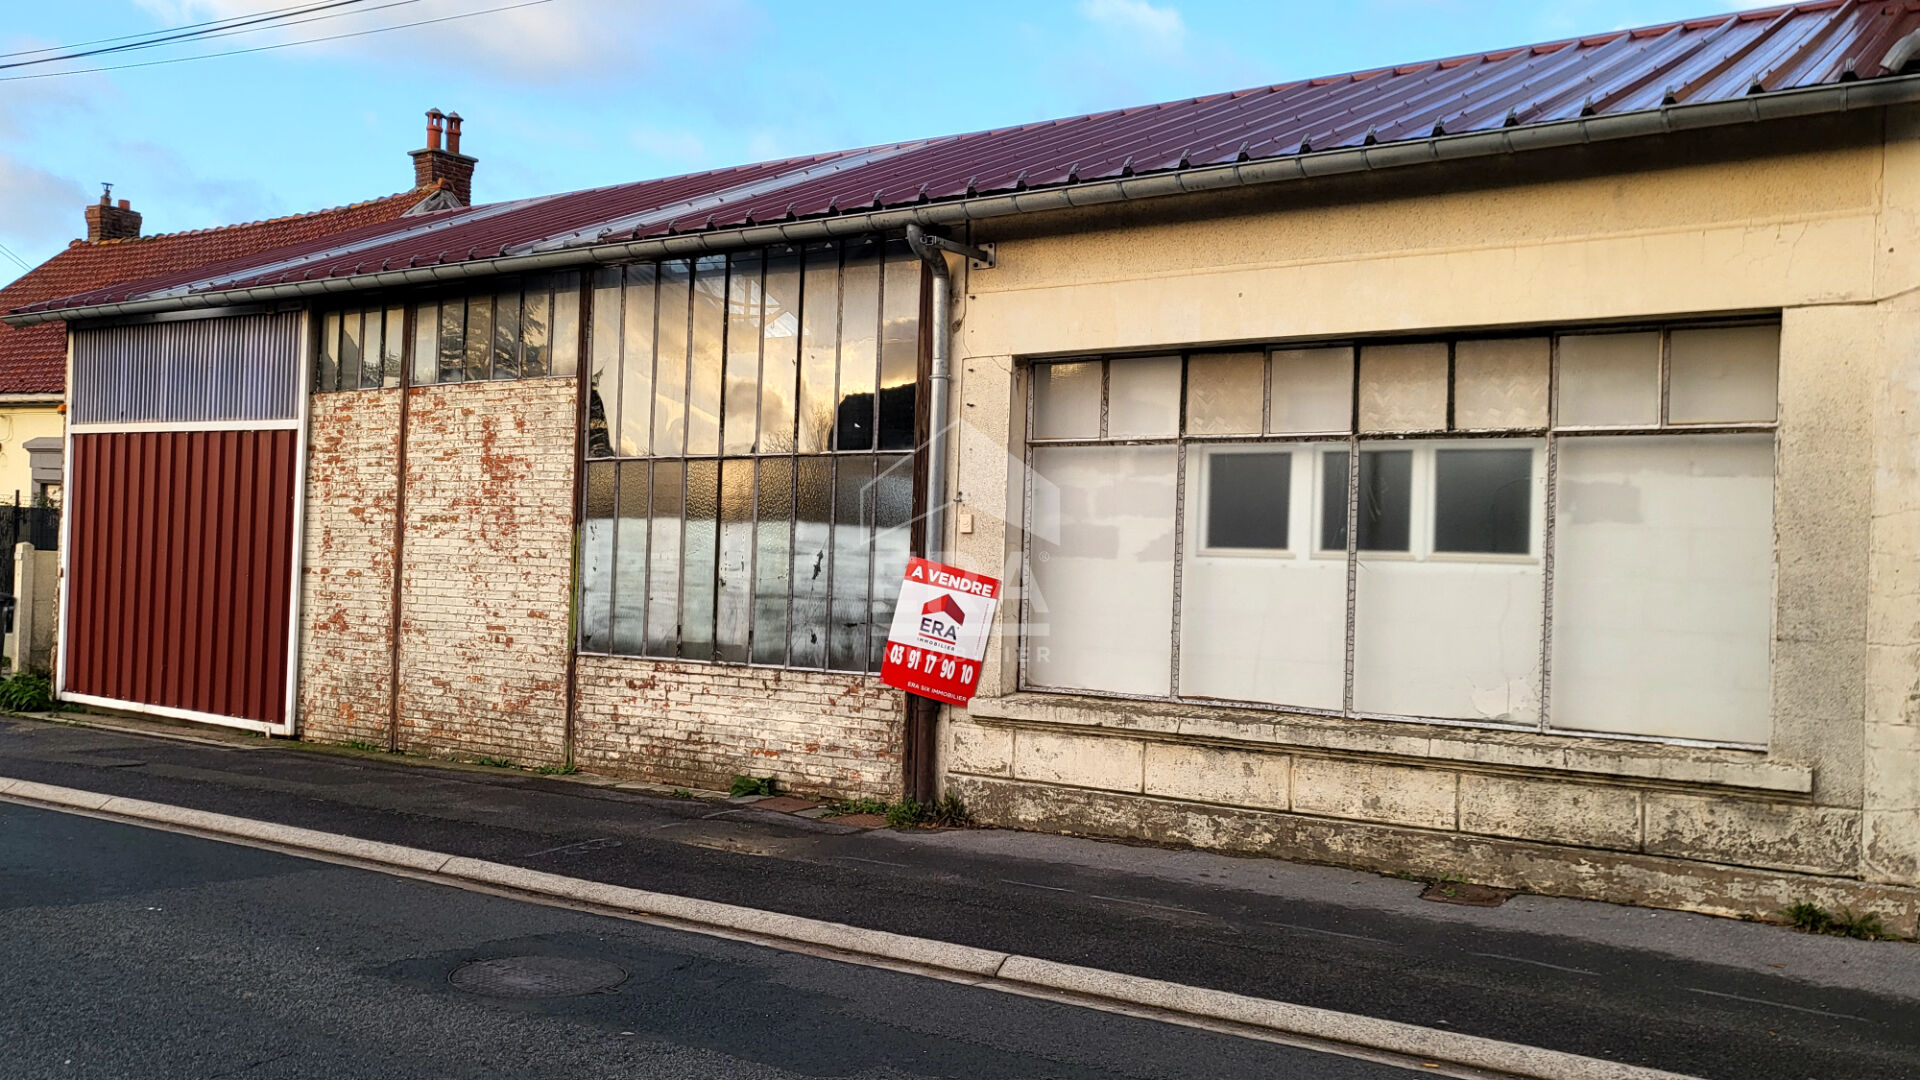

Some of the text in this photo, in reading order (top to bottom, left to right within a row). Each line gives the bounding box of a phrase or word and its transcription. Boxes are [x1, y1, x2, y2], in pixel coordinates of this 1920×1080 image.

[911, 566, 993, 598] A VENDRE
[919, 617, 957, 641] ERA
[917, 637, 955, 652] IMMOBILIER
[890, 644, 973, 685] 03 91 17 90 10
[907, 680, 920, 689] ERA
[931, 688, 967, 702] IMMOBILIER
